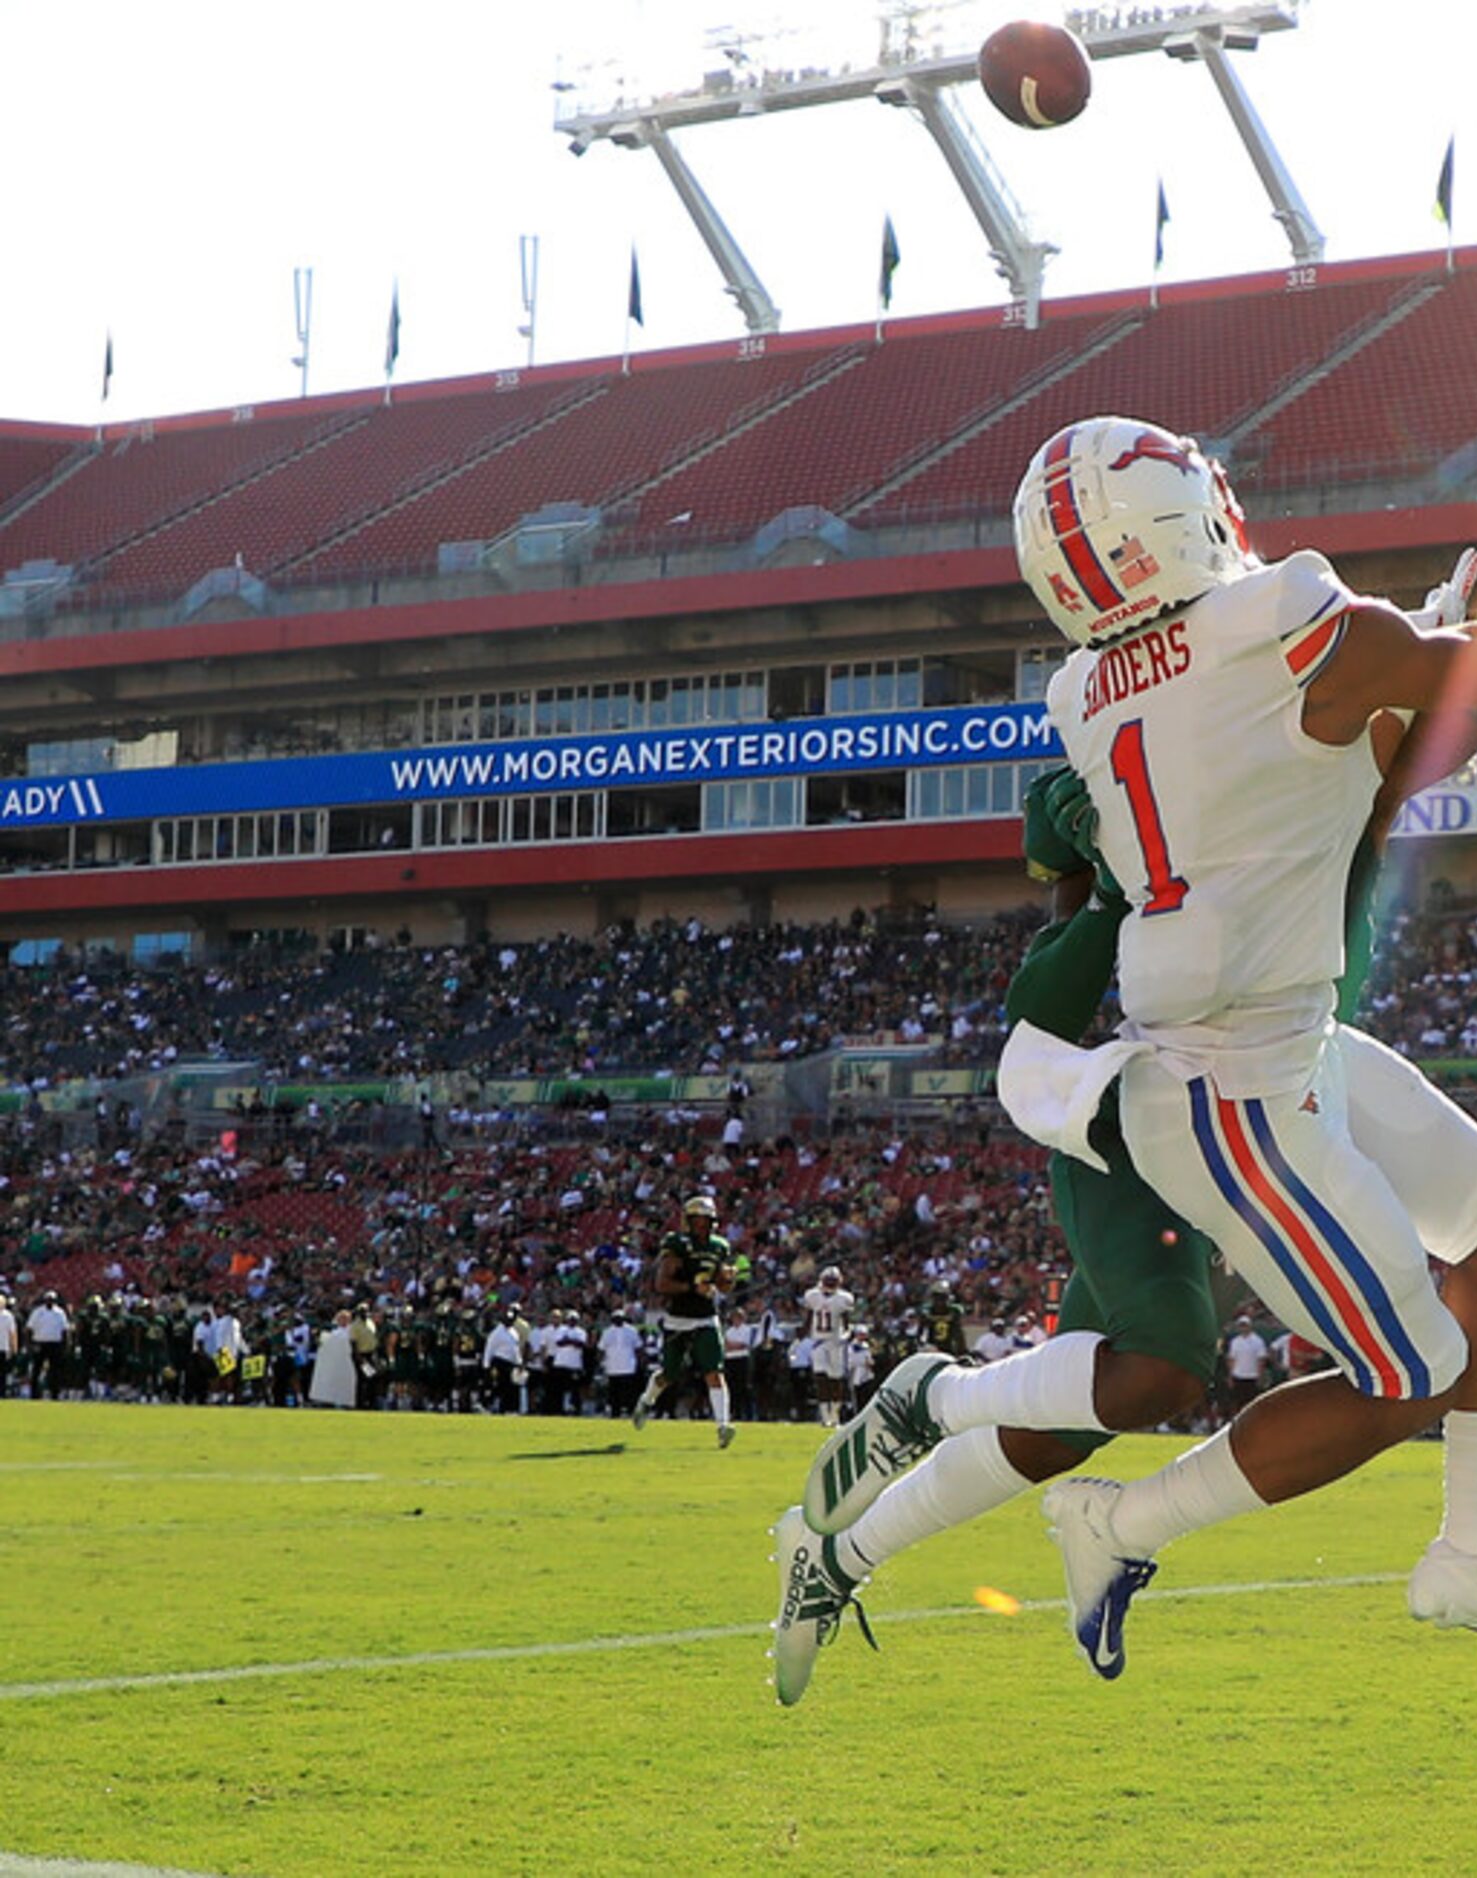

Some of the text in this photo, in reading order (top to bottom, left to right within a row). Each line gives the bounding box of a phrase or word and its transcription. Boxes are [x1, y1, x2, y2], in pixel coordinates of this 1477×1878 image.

[1287, 267, 1316, 286] 312
[391, 713, 1051, 791] WWW.MORGANEXTERIORSINC.COM
[1110, 717, 1190, 917] 1
[779, 1545, 809, 1631] adidas
